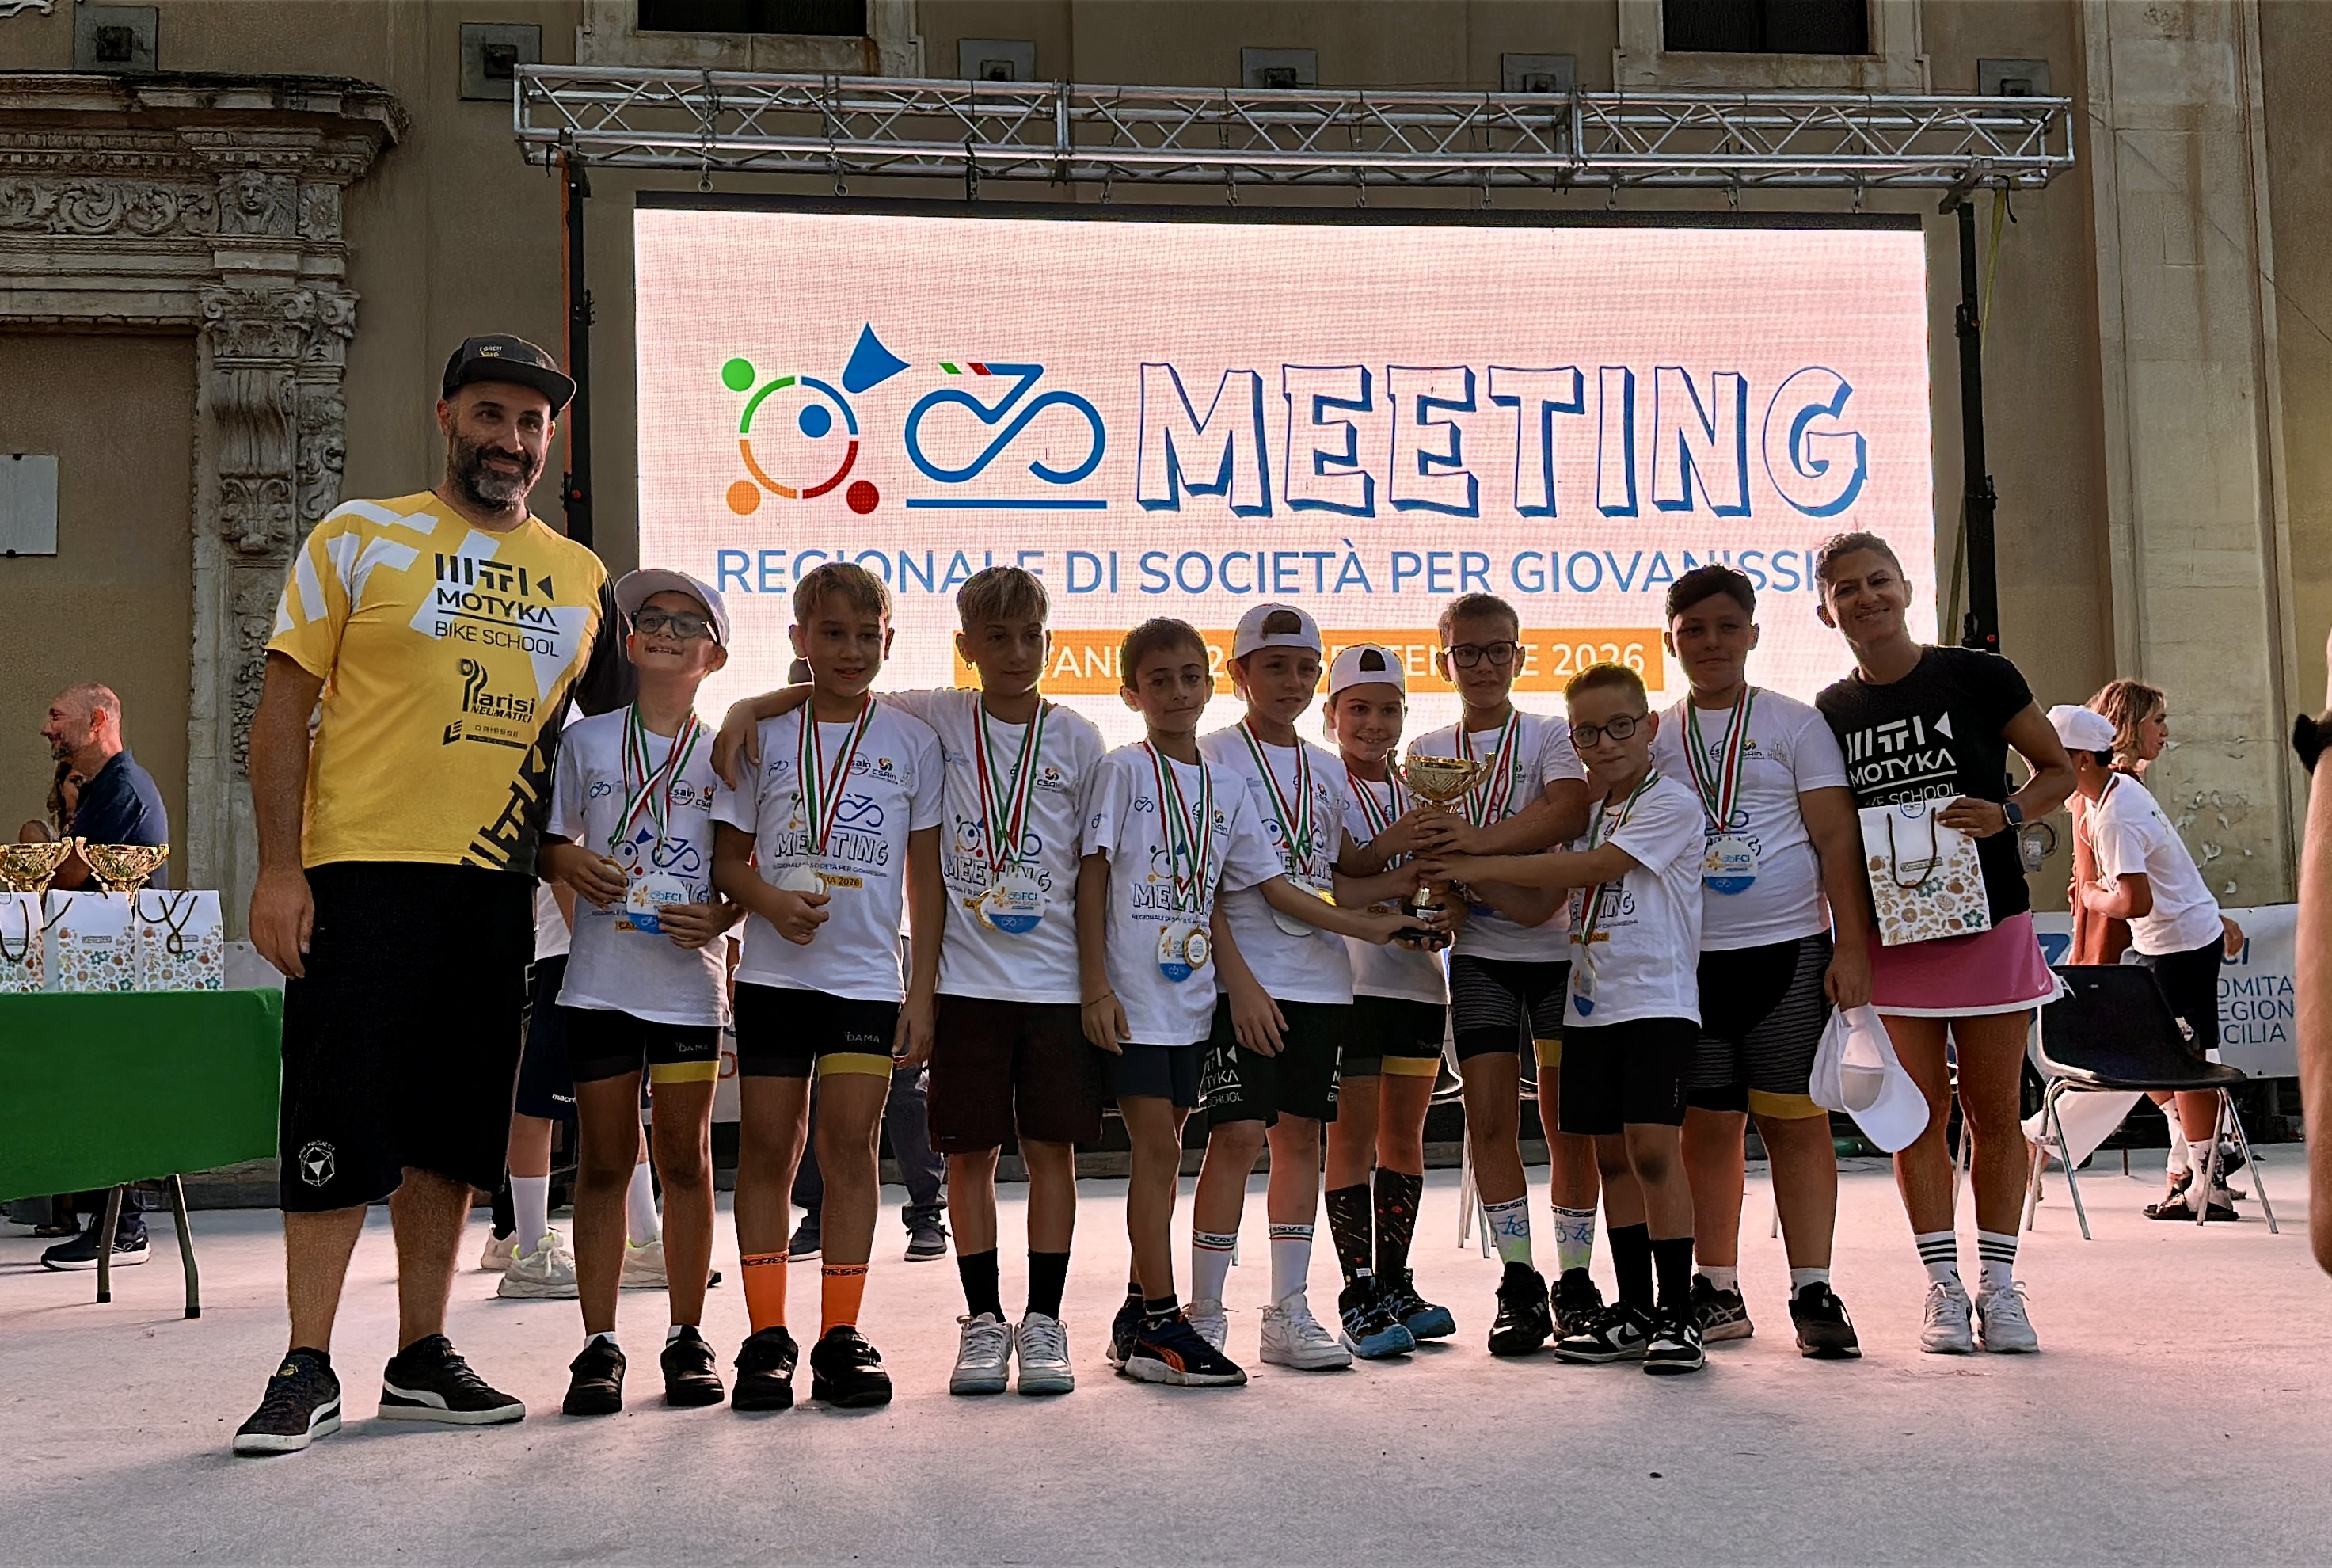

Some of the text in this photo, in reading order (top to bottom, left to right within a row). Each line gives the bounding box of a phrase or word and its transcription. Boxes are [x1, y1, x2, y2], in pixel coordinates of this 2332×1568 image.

[1137, 362, 1869, 518] MEETING
[1067, 550, 1118, 594] DI
[1139, 537, 1373, 594] SOCIETÀ
[1392, 550, 1493, 594] PER
[436, 587, 557, 628] MOTYKA
[435, 621, 560, 658] BIKE SCHOOL
[1551, 642, 1645, 676] 2026
[1848, 748, 1957, 788] MOTYKA
[1889, 782, 1960, 805] SCHOOL
[665, 892, 682, 900] FCI
[838, 877, 860, 886] 2026
